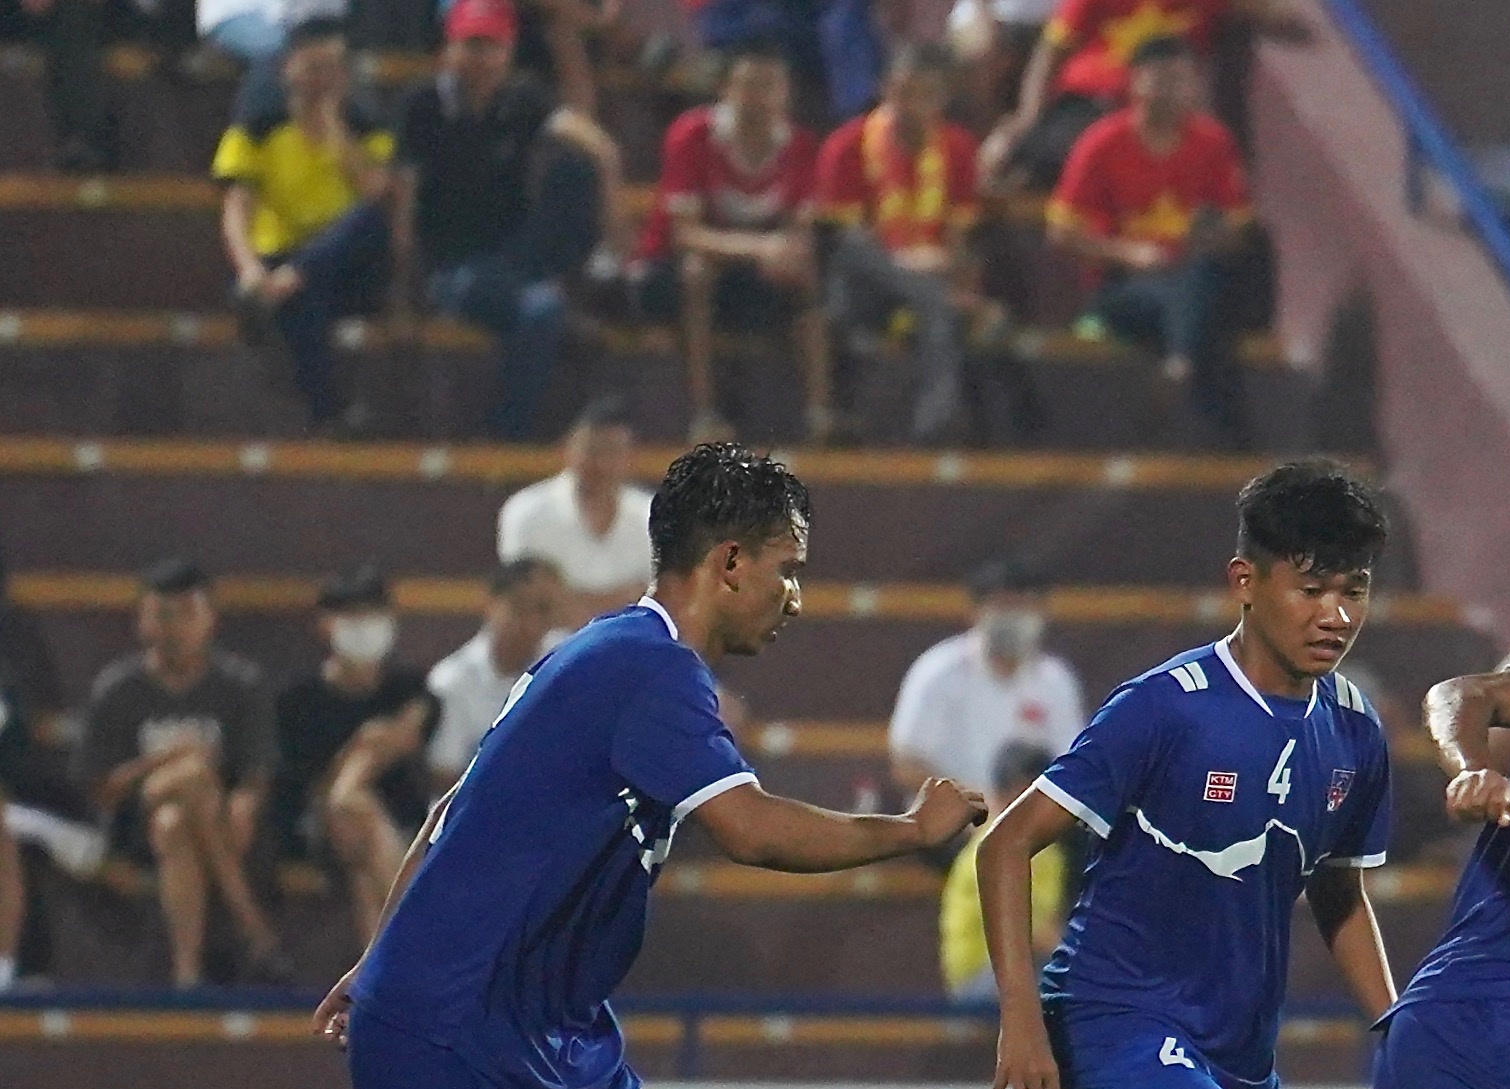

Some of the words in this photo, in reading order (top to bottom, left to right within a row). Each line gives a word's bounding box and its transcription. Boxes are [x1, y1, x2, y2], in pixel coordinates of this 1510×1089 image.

[1209, 774, 1235, 785] KTM
[1266, 738, 1297, 805] 4
[1207, 788, 1233, 799] CTY
[1158, 1036, 1196, 1069] 4
